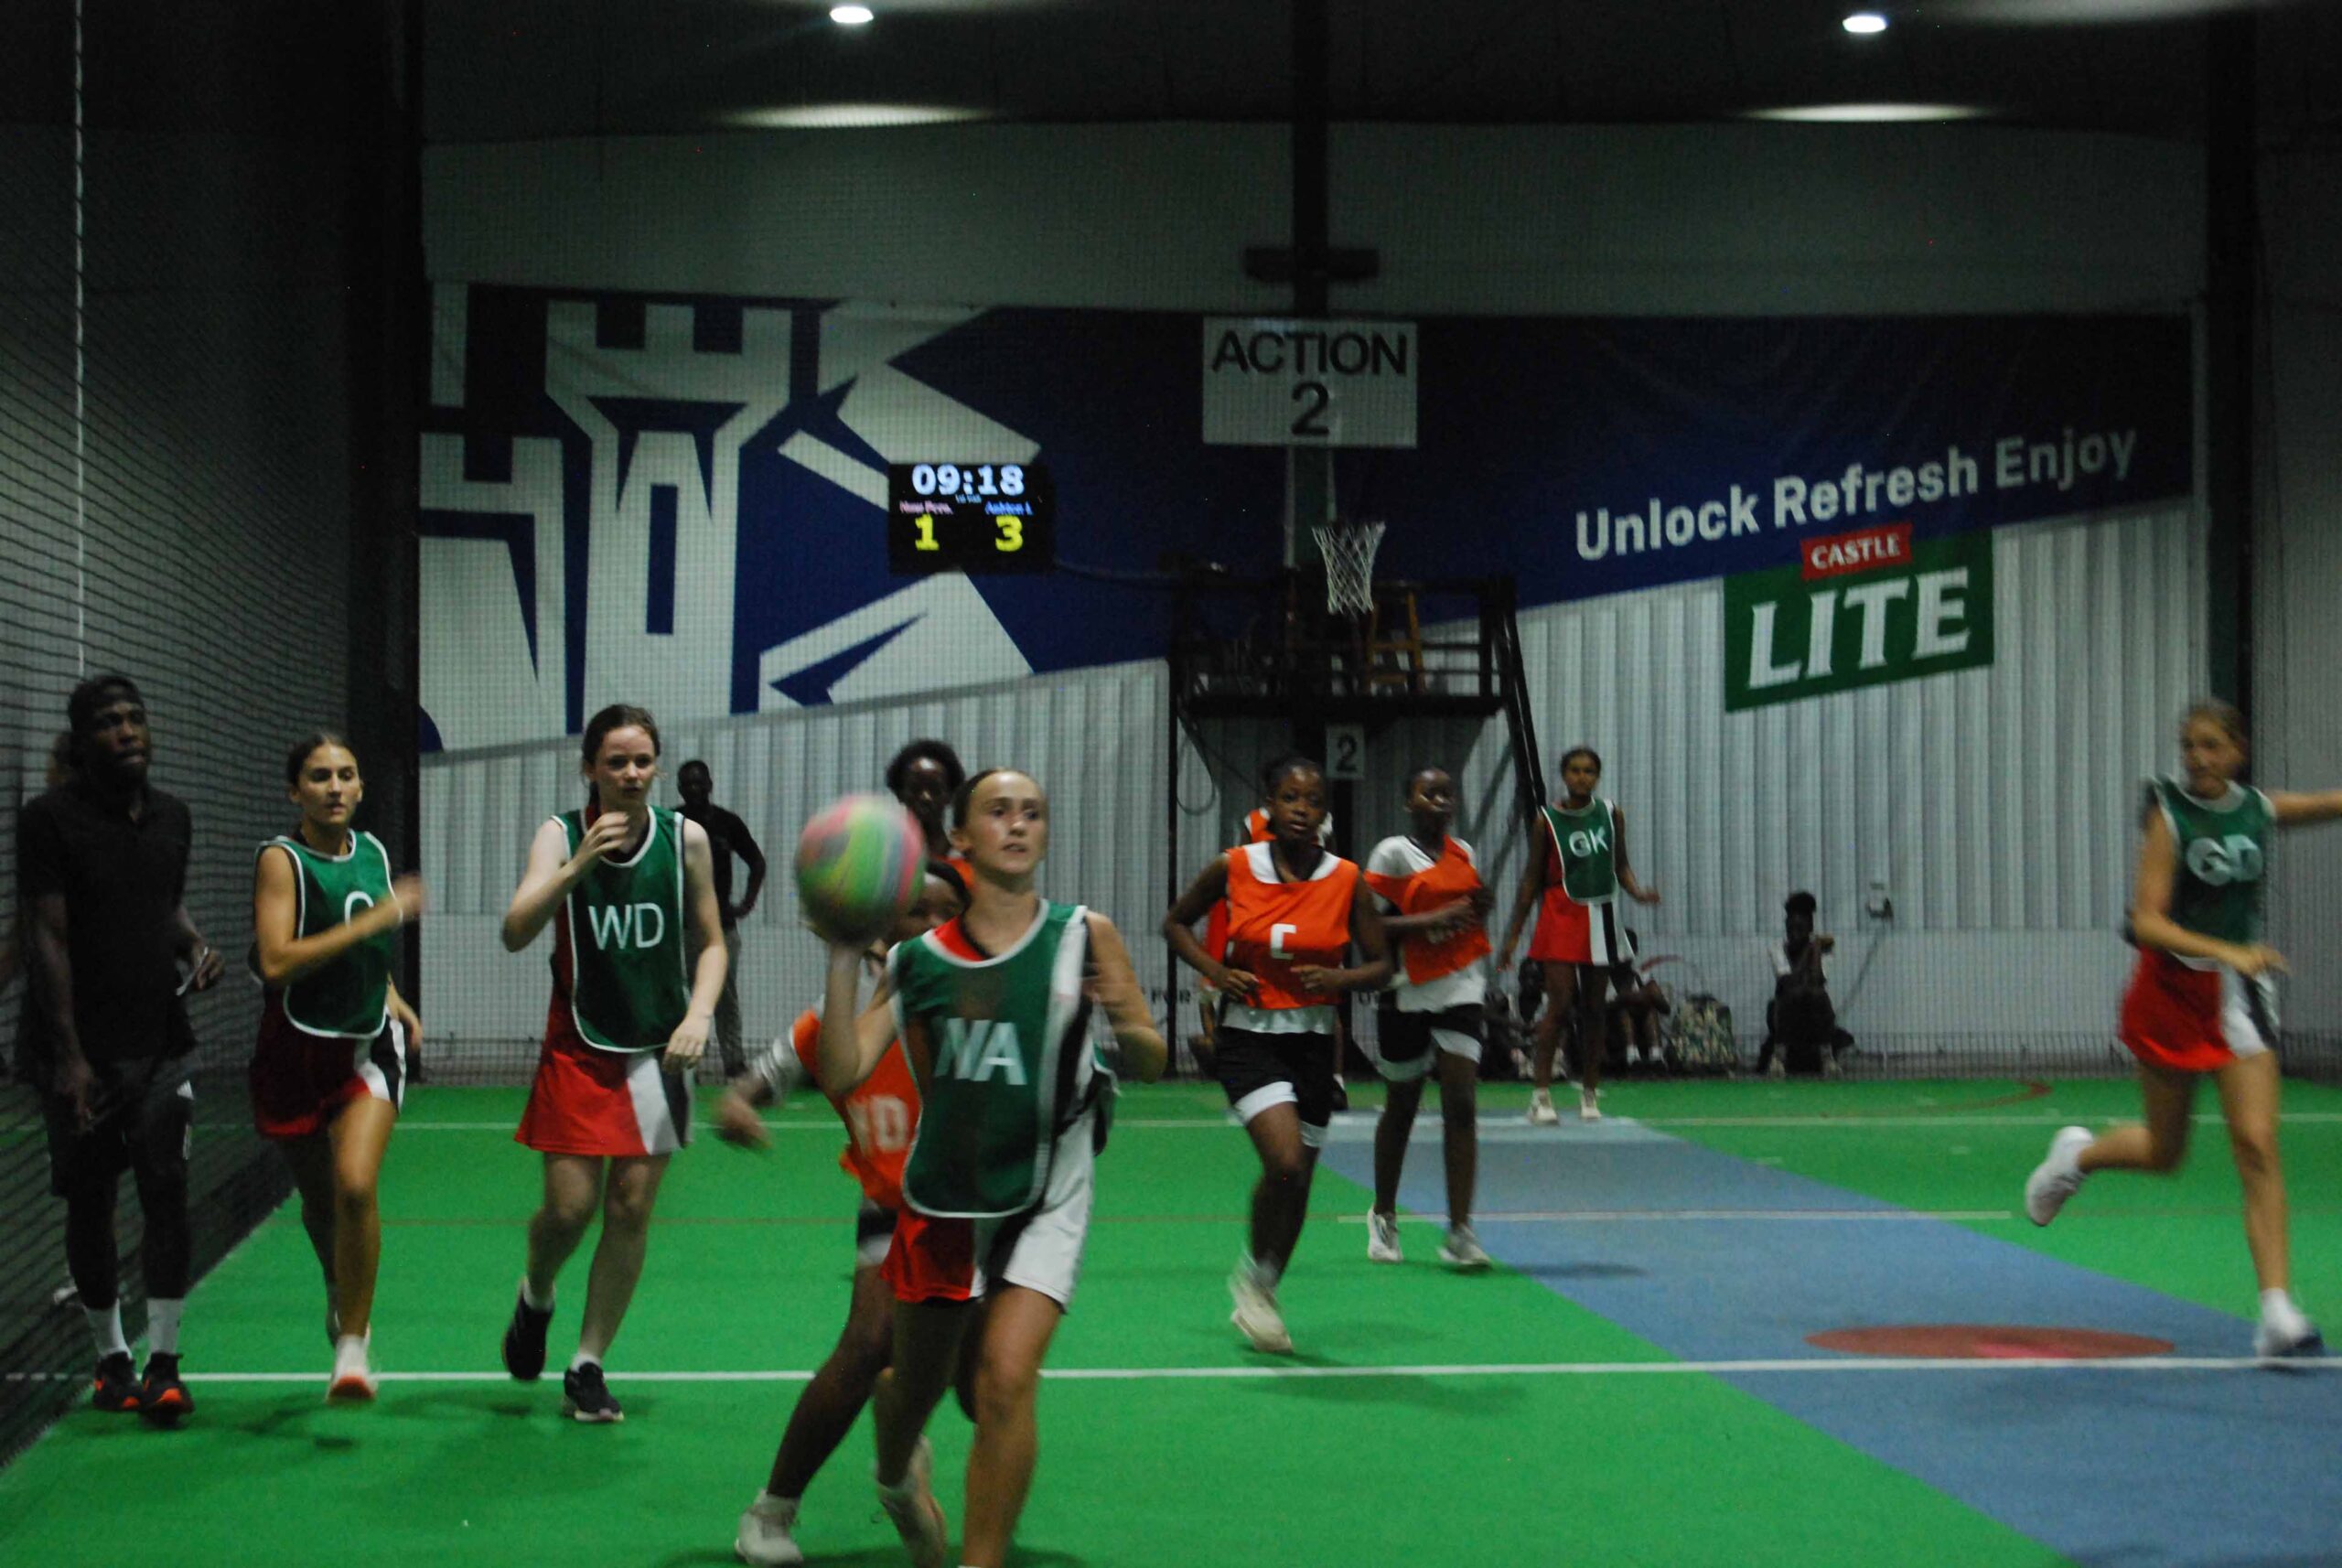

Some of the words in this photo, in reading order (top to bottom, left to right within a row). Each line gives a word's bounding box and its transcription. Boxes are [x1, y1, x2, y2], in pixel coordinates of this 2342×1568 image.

[1211, 330, 1407, 375] ACTION
[1291, 381, 1331, 436] 2
[912, 463, 1026, 496] 09:18
[1575, 484, 1761, 562] Unlock
[1773, 446, 1979, 528] Refresh
[1994, 426, 2137, 491] Enjoy
[915, 513, 940, 551] 1
[995, 513, 1024, 552] 3
[1810, 532, 1901, 571] CASTLE
[1747, 567, 1972, 691] LITE
[1336, 734, 1359, 773] 2
[1568, 826, 1609, 857] GK
[587, 901, 665, 951] WD
